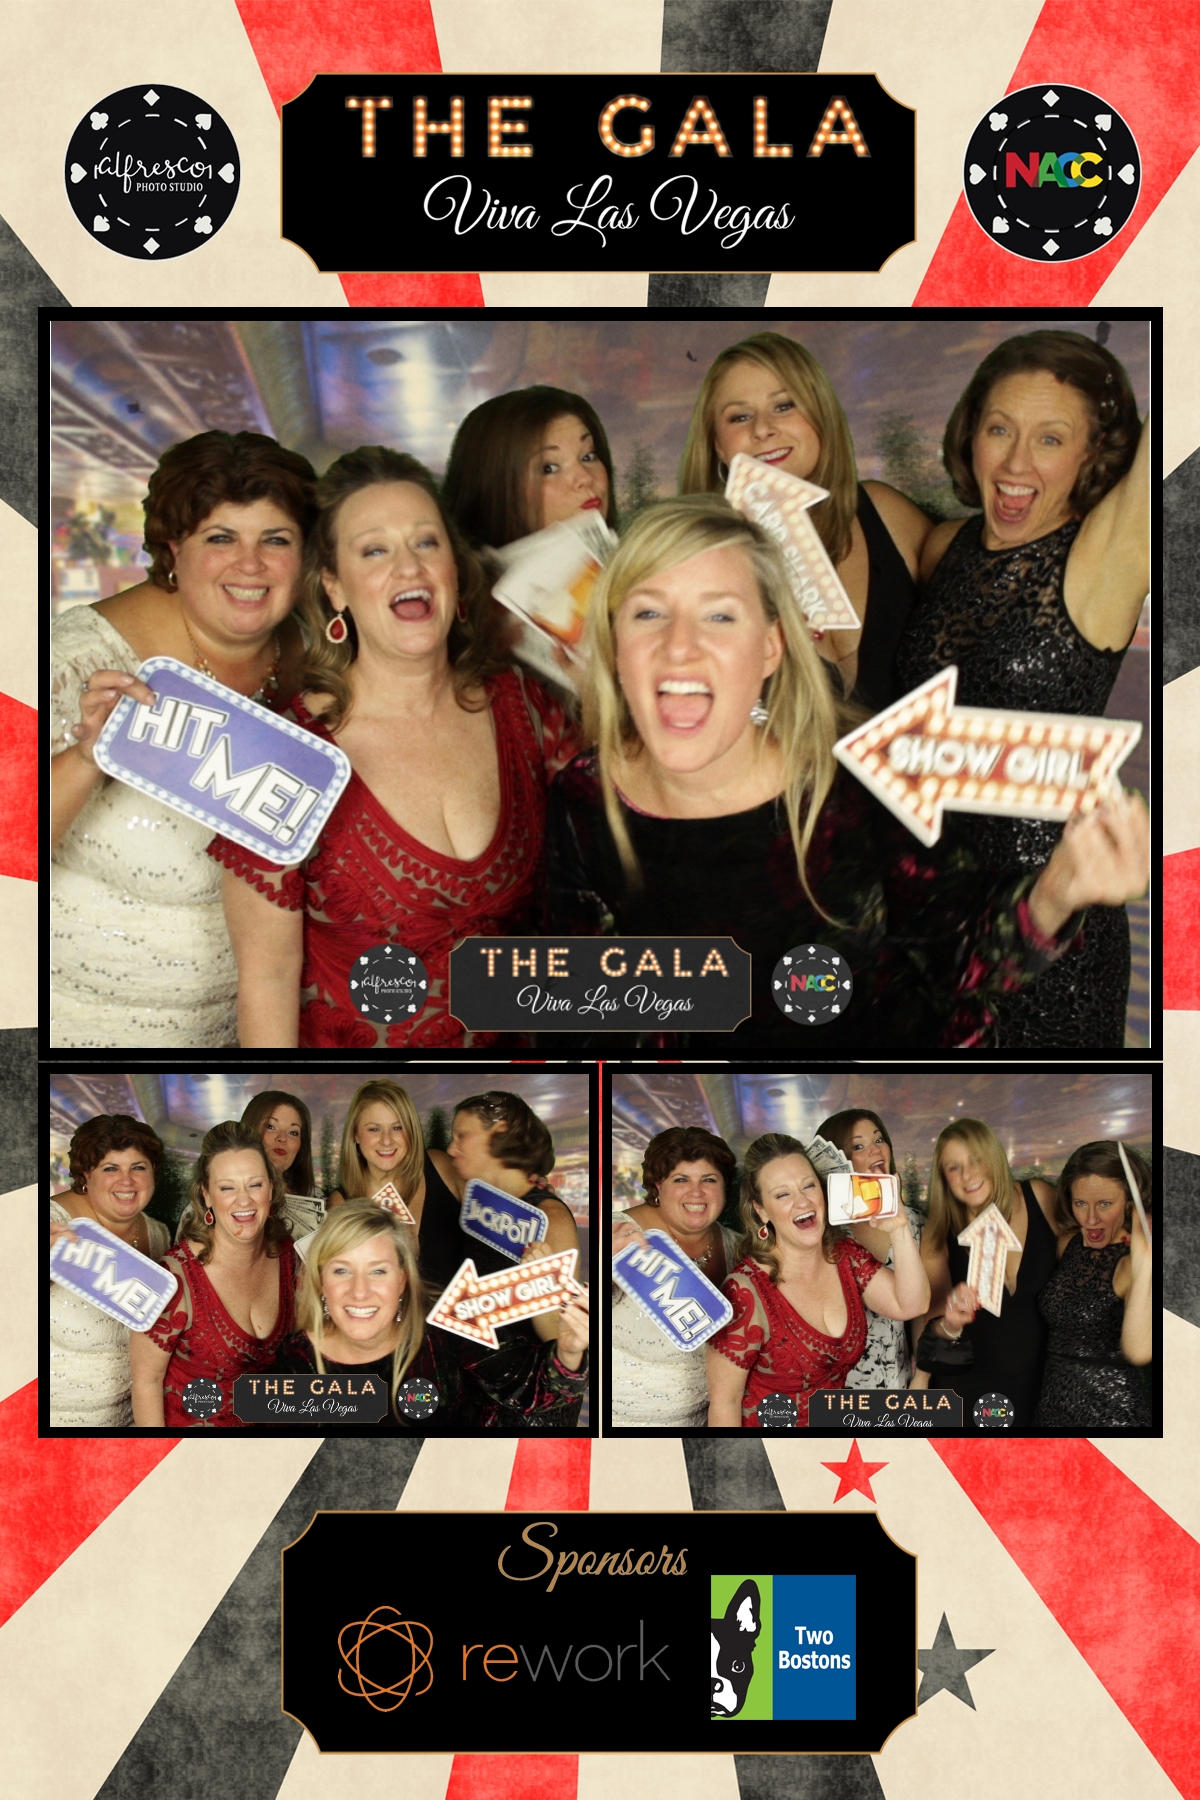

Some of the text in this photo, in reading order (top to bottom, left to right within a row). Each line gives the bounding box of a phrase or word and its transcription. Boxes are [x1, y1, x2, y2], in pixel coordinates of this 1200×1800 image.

[128, 692, 230, 758] HIT
[189, 733, 323, 846] ME!
[888, 734, 1092, 790] SHOW GIRL
[60, 1236, 118, 1273] HIT
[626, 1245, 684, 1285] HIT
[91, 1260, 162, 1323] ME!
[454, 1274, 564, 1321] SHOW GIRL
[648, 1276, 715, 1342] ME!
